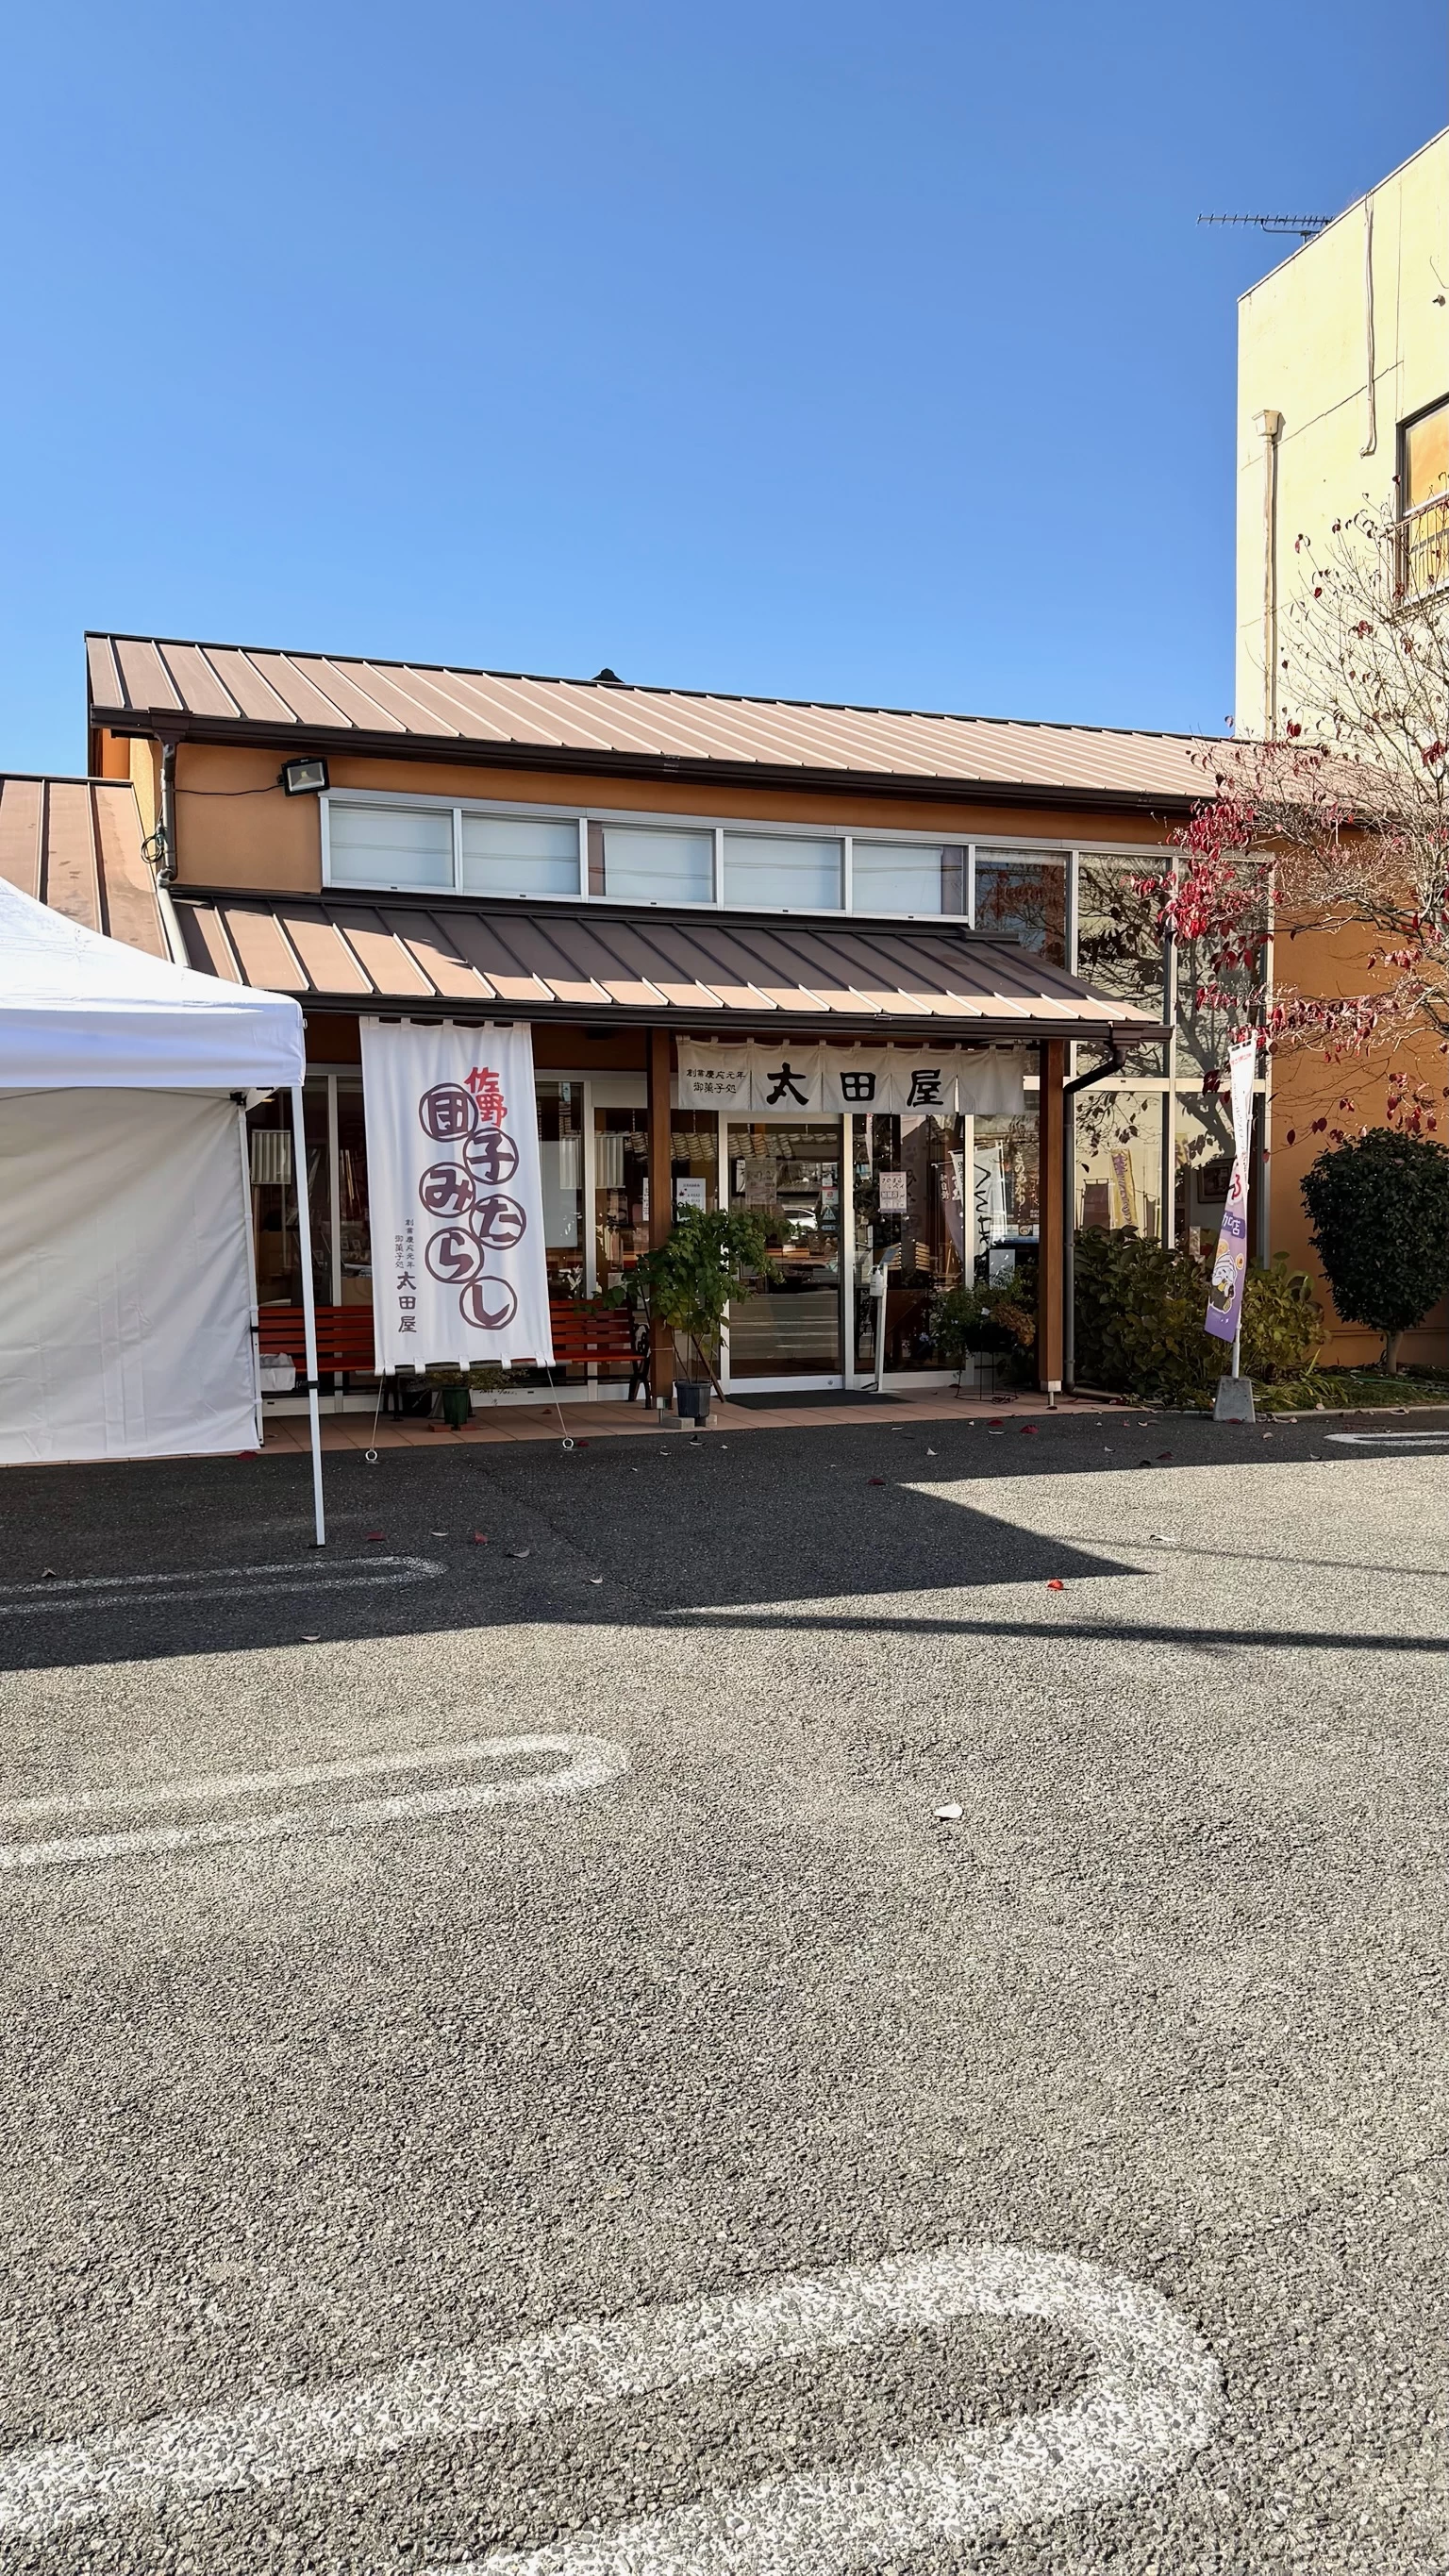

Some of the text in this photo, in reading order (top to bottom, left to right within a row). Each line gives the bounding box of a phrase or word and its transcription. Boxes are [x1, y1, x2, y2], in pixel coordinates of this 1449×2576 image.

[463, 1066, 508, 1129] 佐野
[693, 1081, 737, 1094] 御菓子処
[766, 1062, 944, 1108] 太田屋
[396, 1271, 417, 1333] 太田屋
